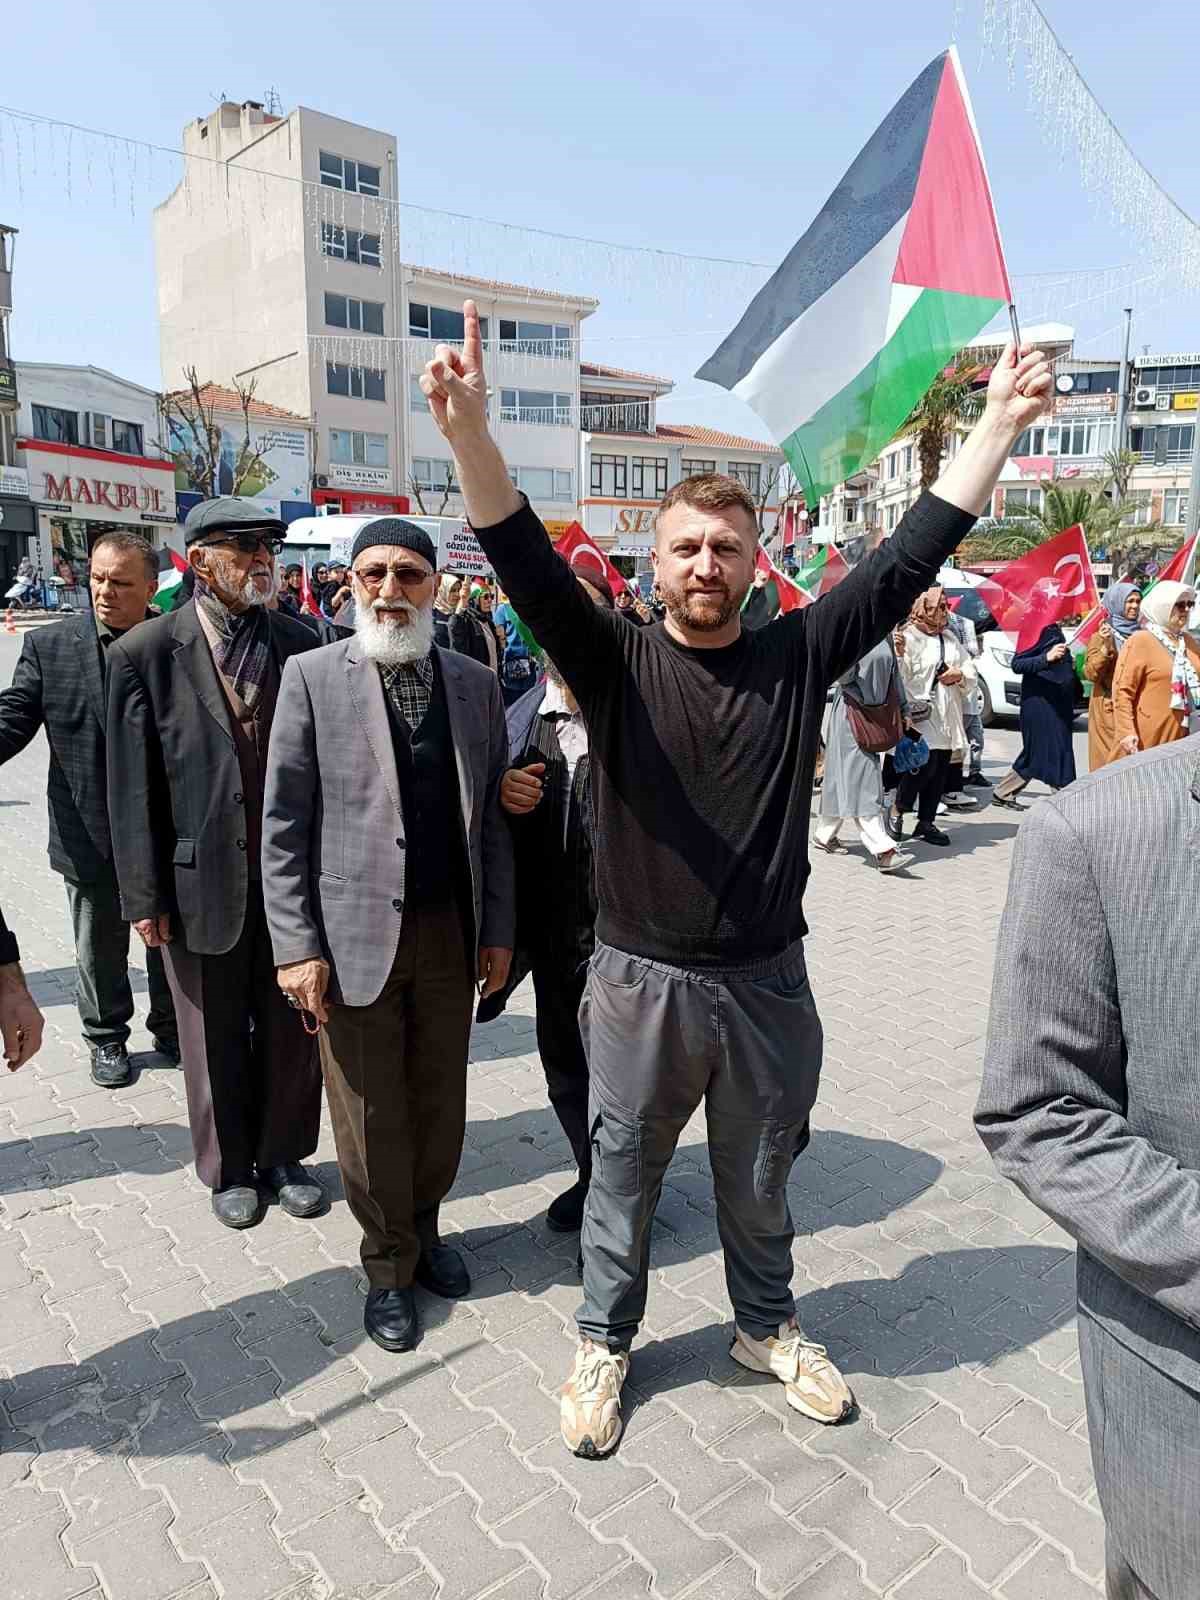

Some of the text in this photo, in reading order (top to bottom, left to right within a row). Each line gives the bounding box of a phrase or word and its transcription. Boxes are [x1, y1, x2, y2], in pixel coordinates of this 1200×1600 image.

[42, 471, 167, 512] MAKBUL
[615, 508, 656, 533] SE
[453, 533, 480, 543] DÜNYA
[446, 542, 465, 551] GÖZÜ
[472, 553, 487, 563] SUÇ
